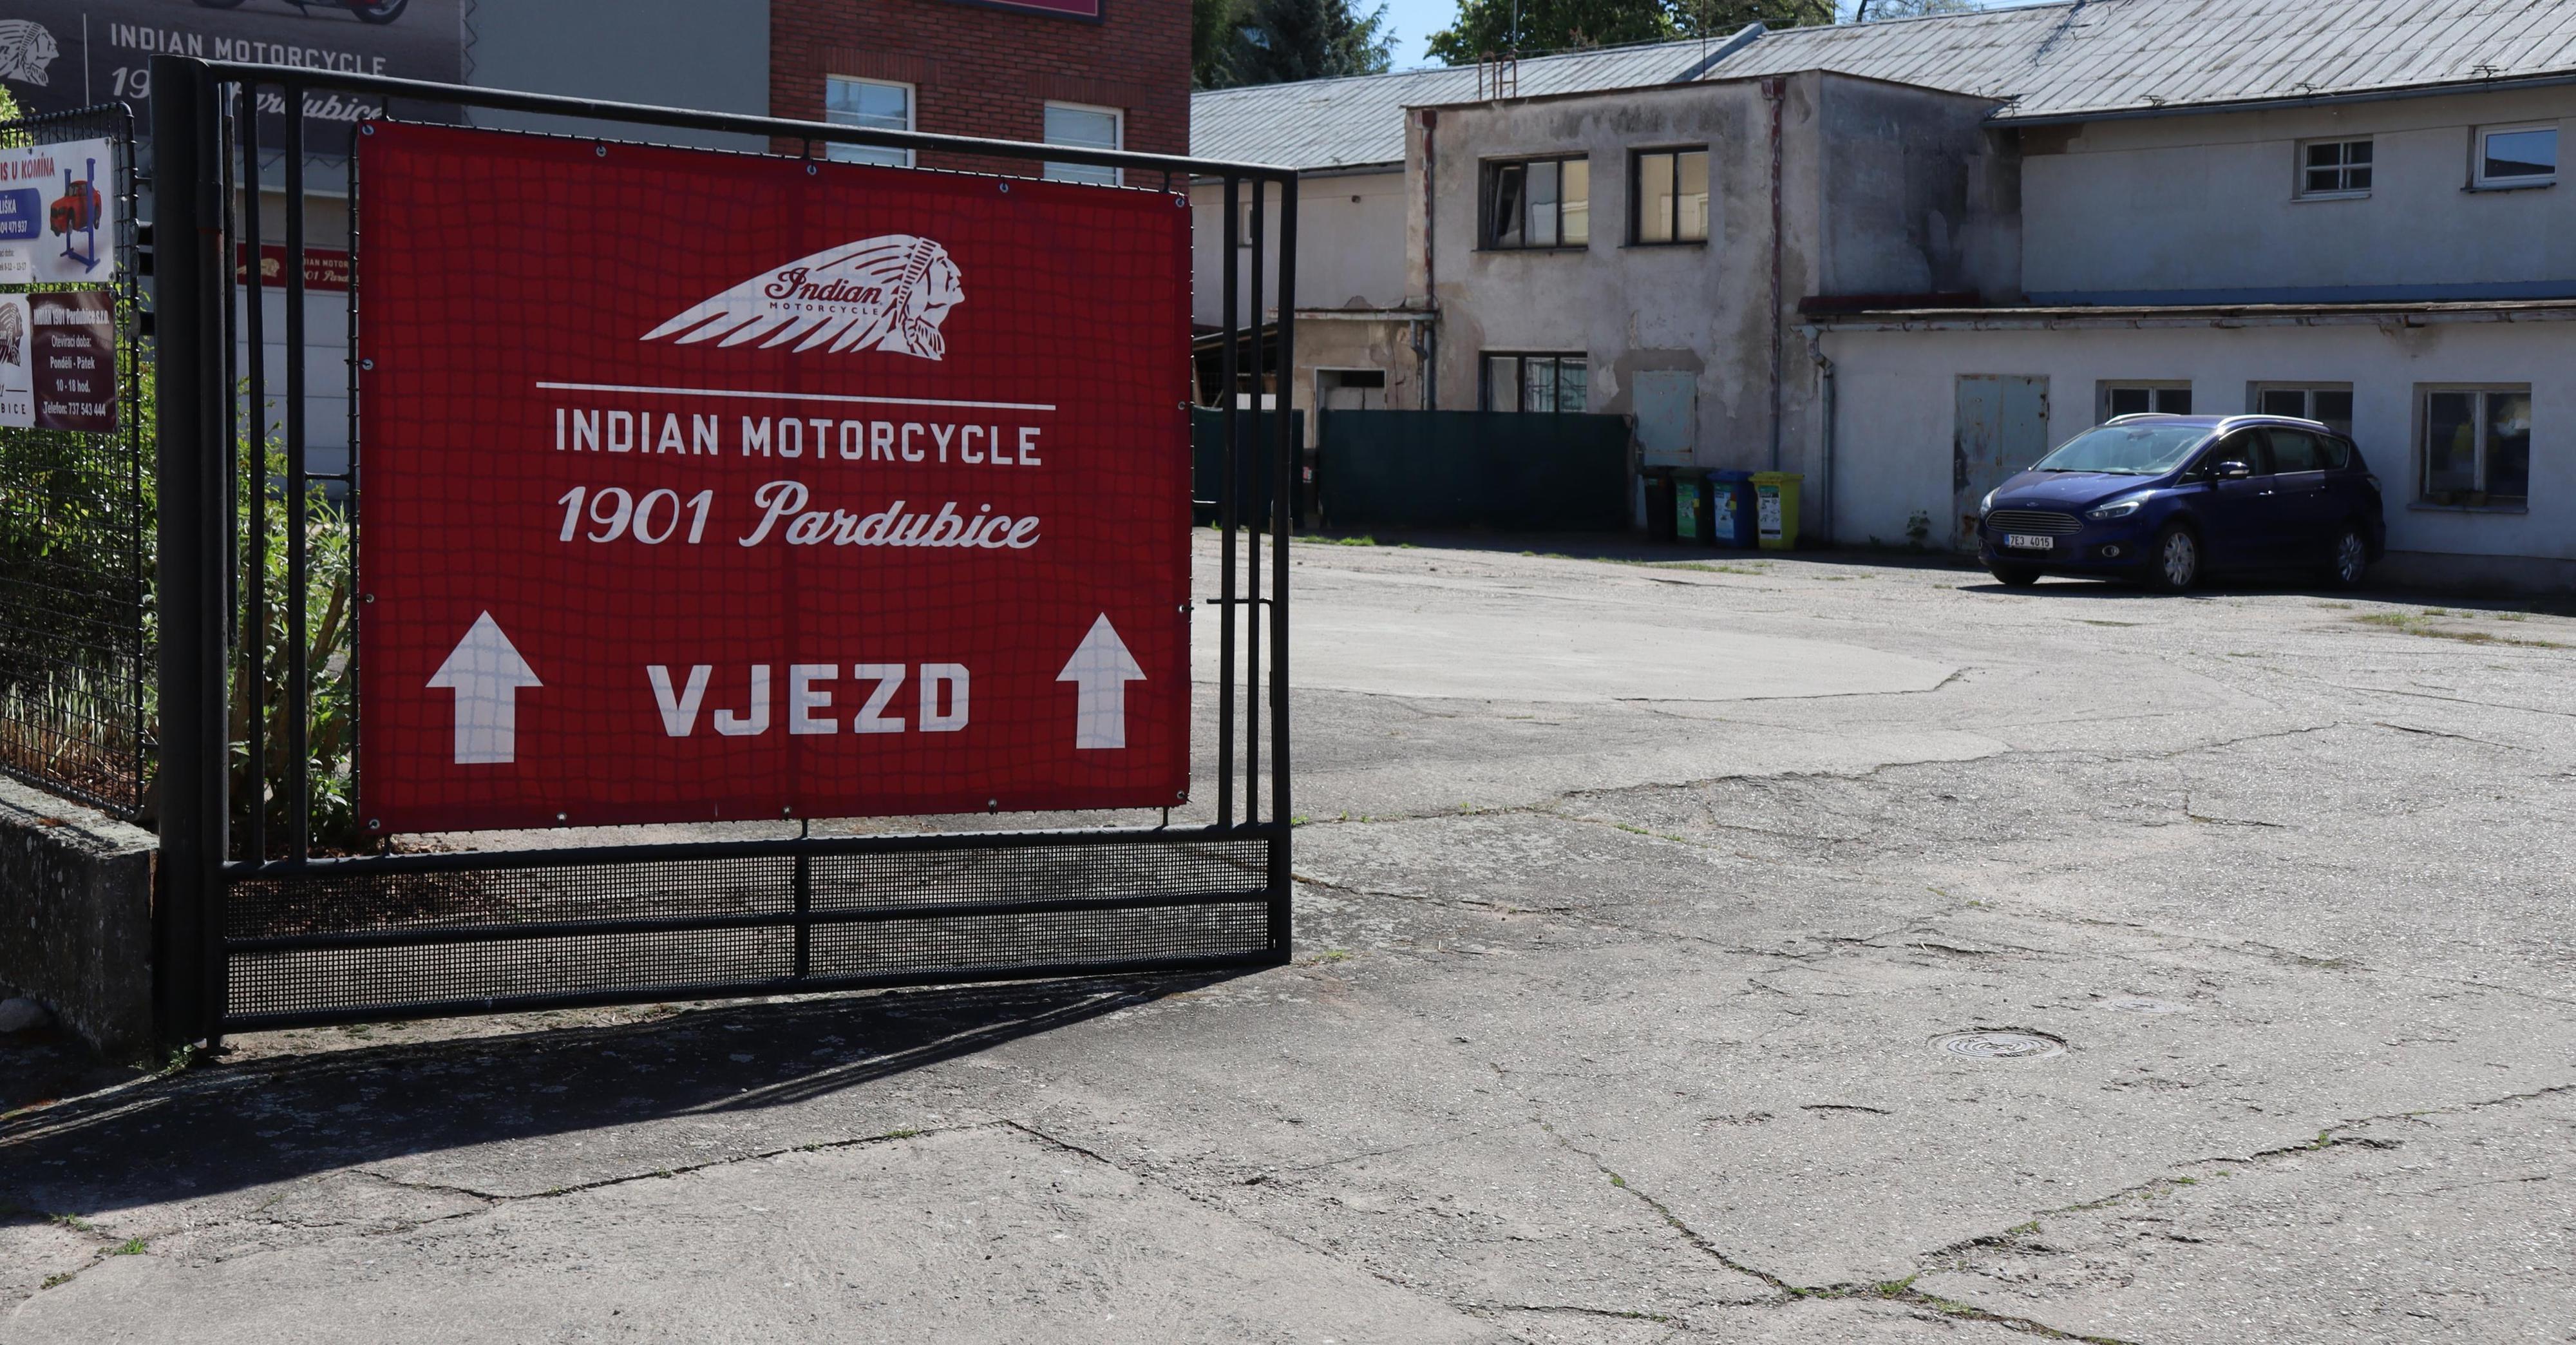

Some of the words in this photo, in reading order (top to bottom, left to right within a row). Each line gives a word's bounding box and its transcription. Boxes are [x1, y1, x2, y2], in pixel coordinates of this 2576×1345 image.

[111, 23, 203, 57] INDIAN
[215, 37, 386, 77] MOTORCYCLE
[12, 160, 17, 180] U
[21, 151, 55, 180] KOMÍNA
[17, 220, 28, 233] 937
[764, 267, 882, 305] Indian
[33, 308, 52, 325] INDIAN
[52, 309, 65, 325] 1901
[66, 308, 95, 325] Pardubice
[96, 310, 109, 325] s.r.o.
[770, 302, 878, 316] MOTORCYCLE
[76, 334, 92, 348] doba:
[77, 355, 95, 370] Pátek
[55, 378, 64, 392] 10
[68, 379, 77, 392] 18
[77, 379, 91, 393] hod.
[43, 401, 68, 414] Telefon:
[68, 401, 79, 415] 737
[80, 402, 93, 417] 543
[94, 403, 106, 417] 444
[555, 407, 719, 457] INDIAN
[741, 415, 1042, 466] MOTORCYCLE
[556, 485, 714, 546] 1901
[738, 479, 1042, 549] Pardubice
[2030, 537, 2050, 547] 4015
[646, 663, 970, 738] VJEZD
